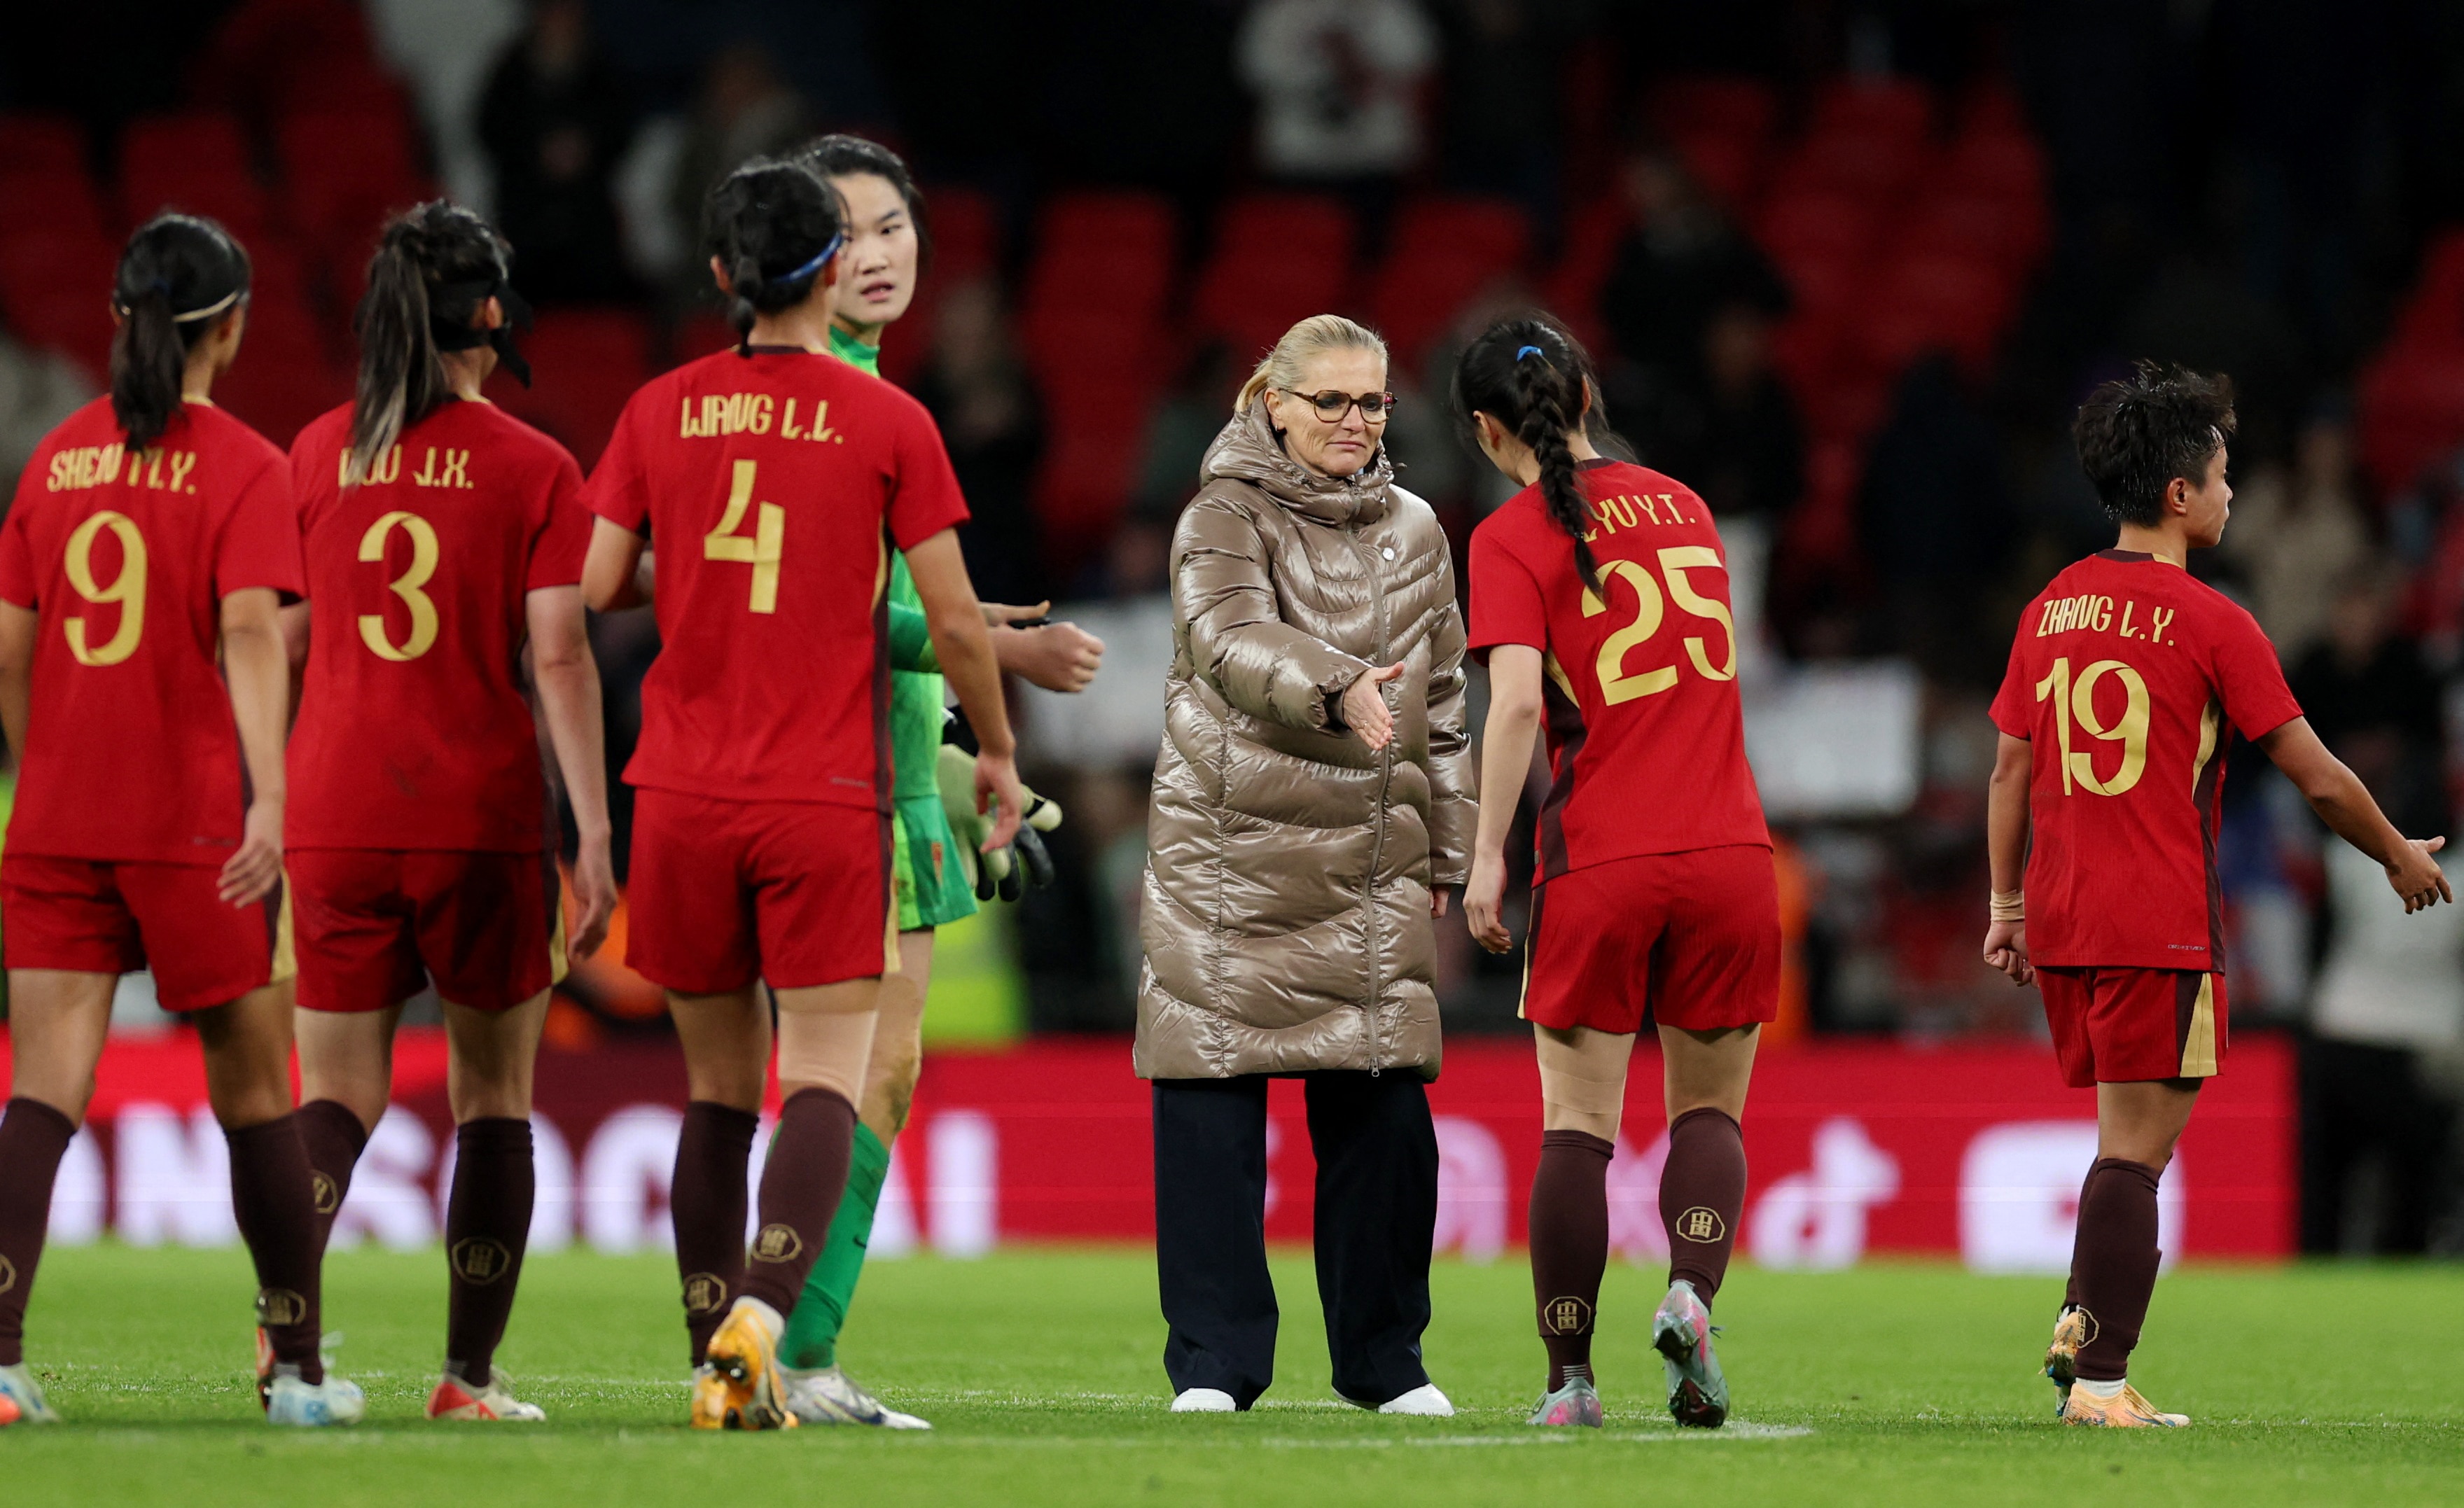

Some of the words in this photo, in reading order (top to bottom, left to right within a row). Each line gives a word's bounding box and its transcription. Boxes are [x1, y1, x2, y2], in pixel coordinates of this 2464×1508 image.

[46, 442, 126, 492] SHEN
[680, 393, 774, 438] WANG
[781, 397, 844, 445] L.L.
[412, 446, 475, 489] J.X.
[704, 459, 785, 614] 4
[1583, 495, 1638, 543] YU
[1633, 494, 1697, 526] Y.T.
[64, 510, 147, 665] 9
[358, 511, 439, 660] 3
[1581, 545, 1736, 706] 25
[2035, 594, 2114, 638] ZHANG
[2119, 600, 2175, 646] L.Y.
[2035, 657, 2150, 797] 19
